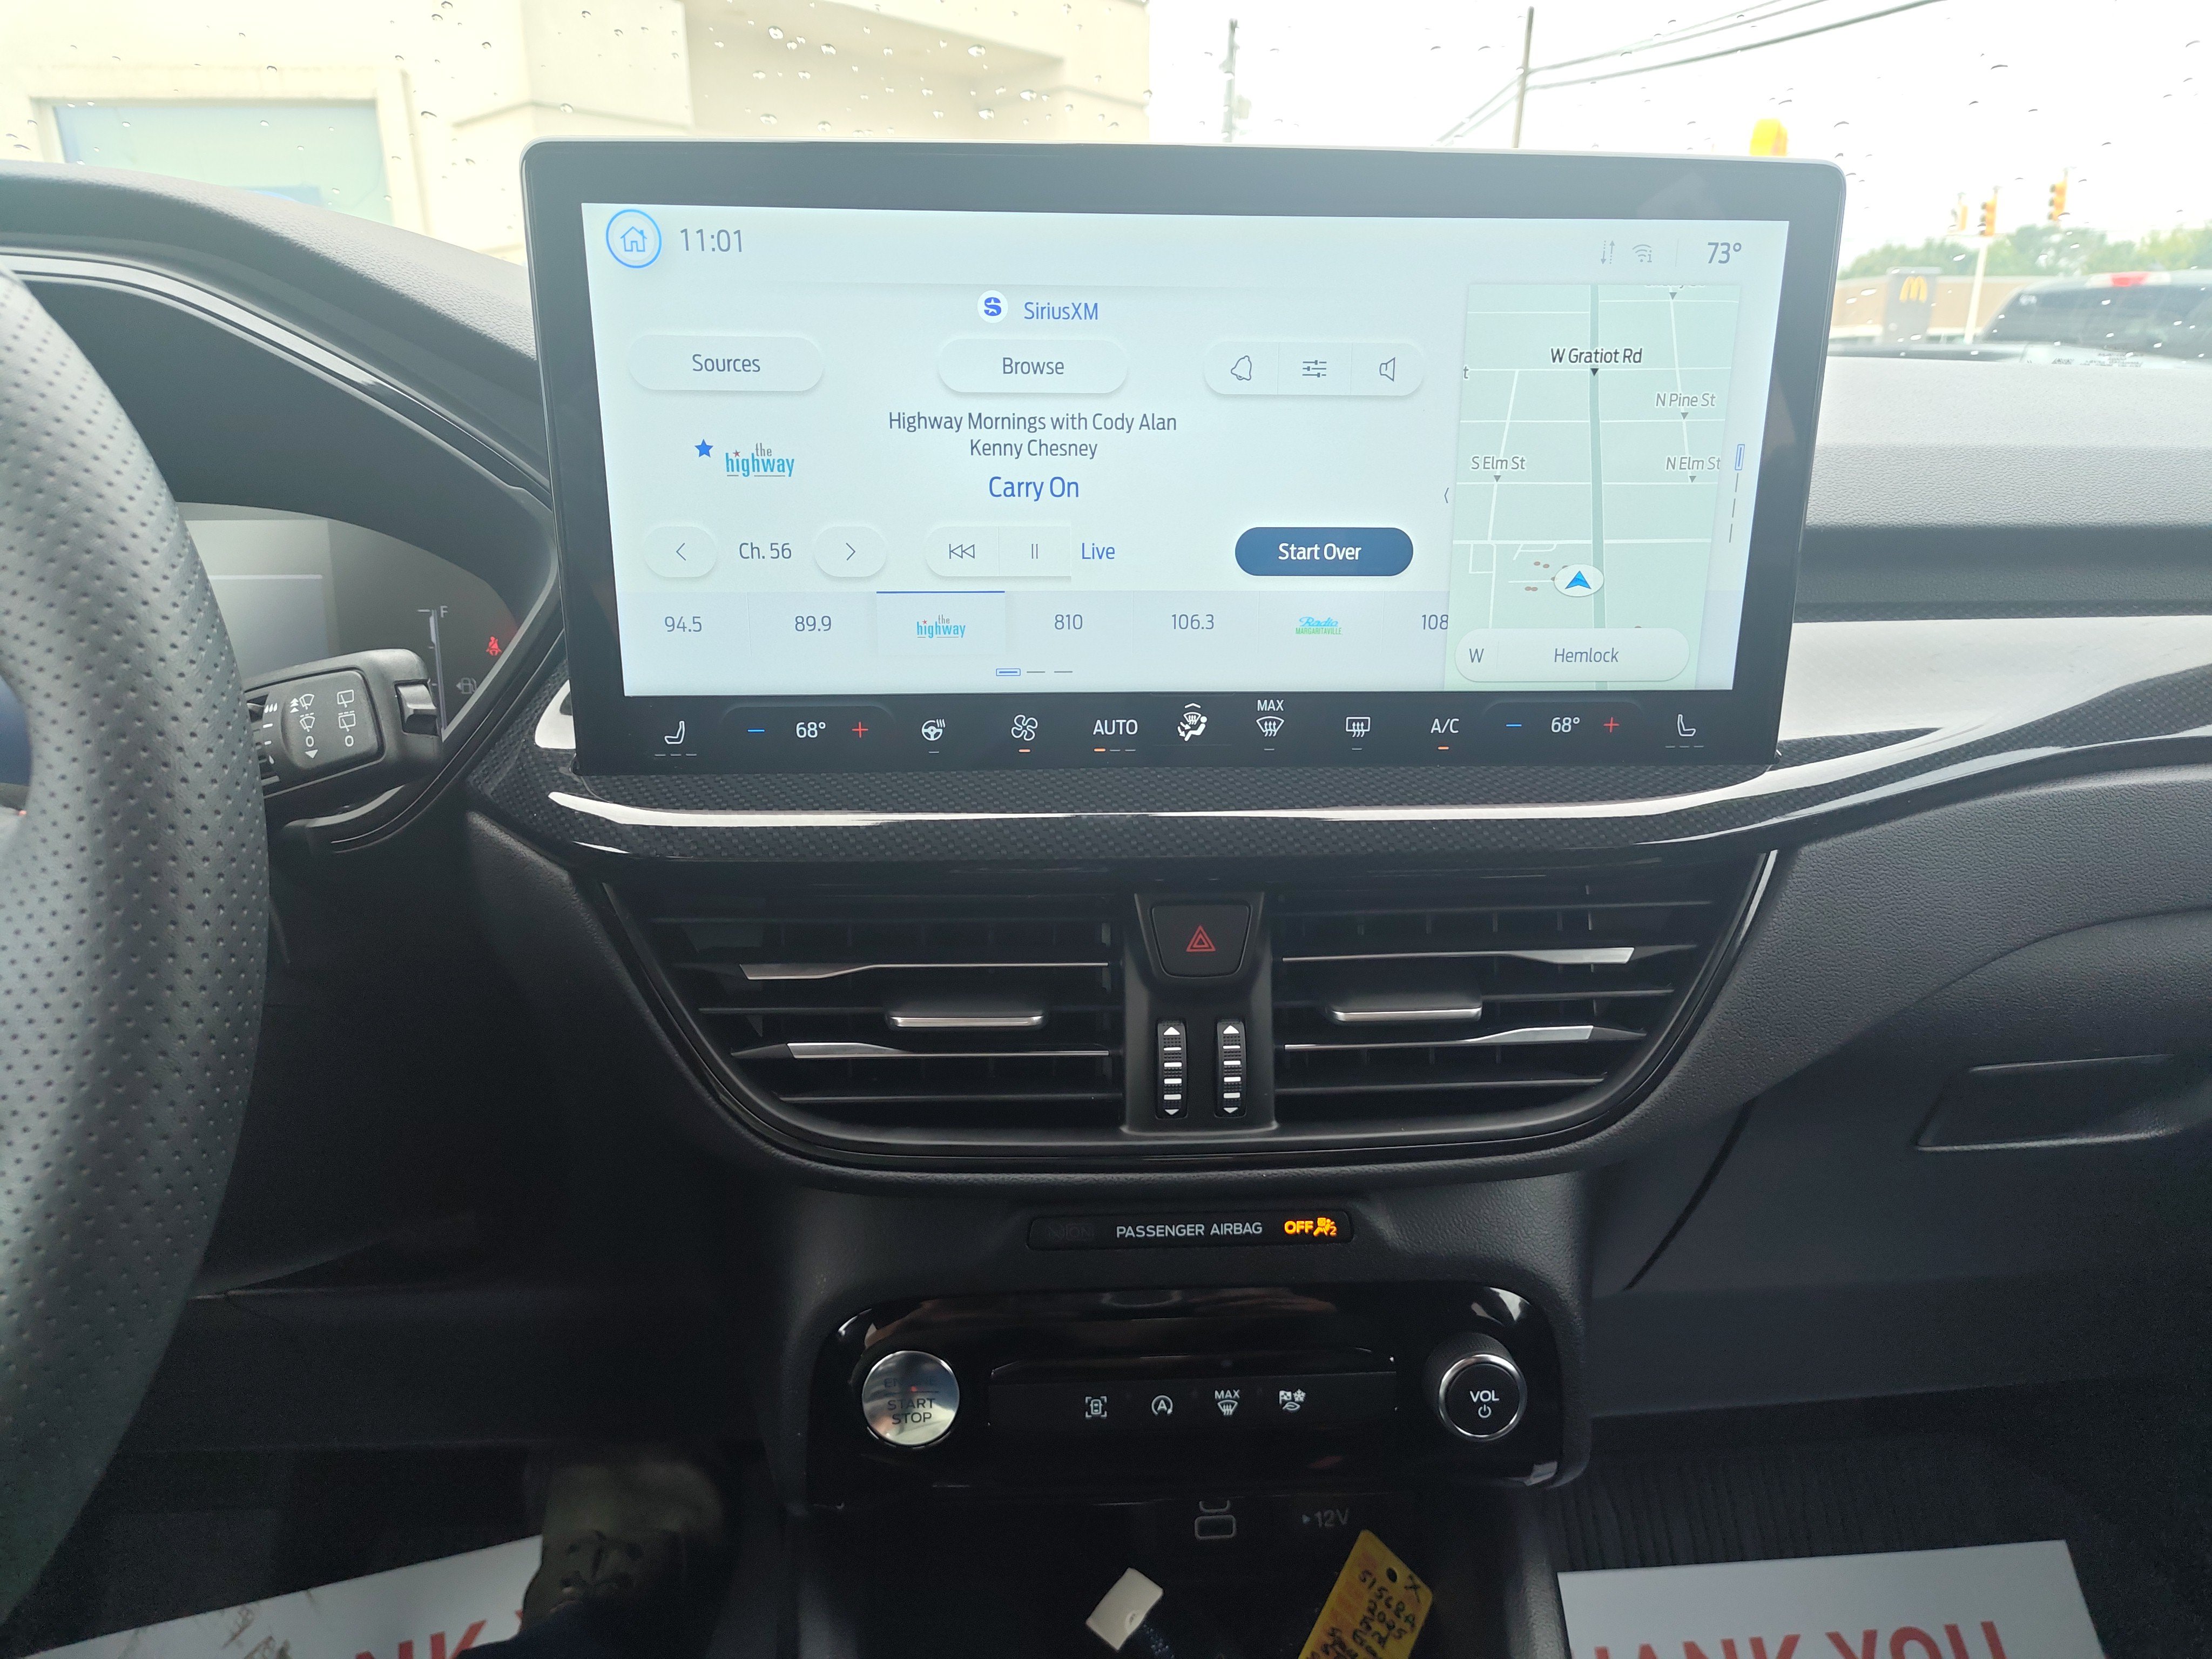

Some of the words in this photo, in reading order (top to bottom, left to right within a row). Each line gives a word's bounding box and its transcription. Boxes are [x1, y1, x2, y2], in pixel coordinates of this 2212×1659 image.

[680, 228, 743, 253] 11:01
[1708, 242, 1742, 264] 73°
[1024, 302, 1097, 320] SiriusXM
[692, 354, 760, 372] Sources
[1551, 348, 1565, 362] W
[1569, 348, 1620, 363] Gratiot
[1623, 348, 1642, 363] Rd
[1003, 358, 1064, 374] Browse
[1656, 394, 1665, 406] N
[1669, 394, 1697, 408] Pine
[1701, 393, 1716, 407] St
[889, 412, 962, 433] Highway
[968, 413, 1046, 433] Mornings
[1050, 413, 1087, 430] with
[1093, 413, 1134, 433] Cody
[1139, 413, 1176, 430] Alan
[756, 443, 772, 456] the
[971, 440, 1023, 459] Kenny
[1028, 439, 1097, 460] Chesney
[725, 453, 794, 477] highway
[1472, 456, 1479, 469] S
[1483, 456, 1508, 469] Elm
[1512, 456, 1525, 469] St
[1666, 457, 1676, 470] N
[1679, 457, 1704, 470] Elm
[1707, 457, 1721, 470] St
[989, 476, 1044, 502] Carry
[1050, 477, 1078, 497] On
[739, 542, 765, 559] Ch.
[771, 543, 791, 559] 56
[1082, 543, 1115, 559] Live
[1279, 543, 1320, 559] Start
[1324, 543, 1361, 559] Over
[440, 605, 448, 617] F
[665, 616, 702, 632] 94.5
[795, 616, 831, 631] 89.9
[938, 614, 950, 624] the
[1055, 615, 1082, 630] 810
[1172, 614, 1213, 629] 106.3
[1299, 616, 1339, 627] Radio
[916, 621, 966, 638] highway
[1469, 649, 1484, 663] W
[1555, 648, 1618, 662] Hemlock
[1258, 700, 1284, 711] MAX
[797, 722, 825, 738] 68°
[1093, 720, 1137, 734] AUTO
[1431, 719, 1459, 733] A/C
[1552, 717, 1580, 732] 68°
[1117, 1224, 1204, 1238] PASSENGER
[1210, 1222, 1262, 1235] AIRBAG
[1284, 1220, 1314, 1235] OFF
[884, 1377, 936, 1388] ENE
[1215, 1390, 1239, 1399] MAX
[1470, 1390, 1499, 1402] VOL
[887, 1398, 936, 1410] START
[892, 1412, 932, 1425] STOP
[1315, 1509, 1349, 1527] 12V
